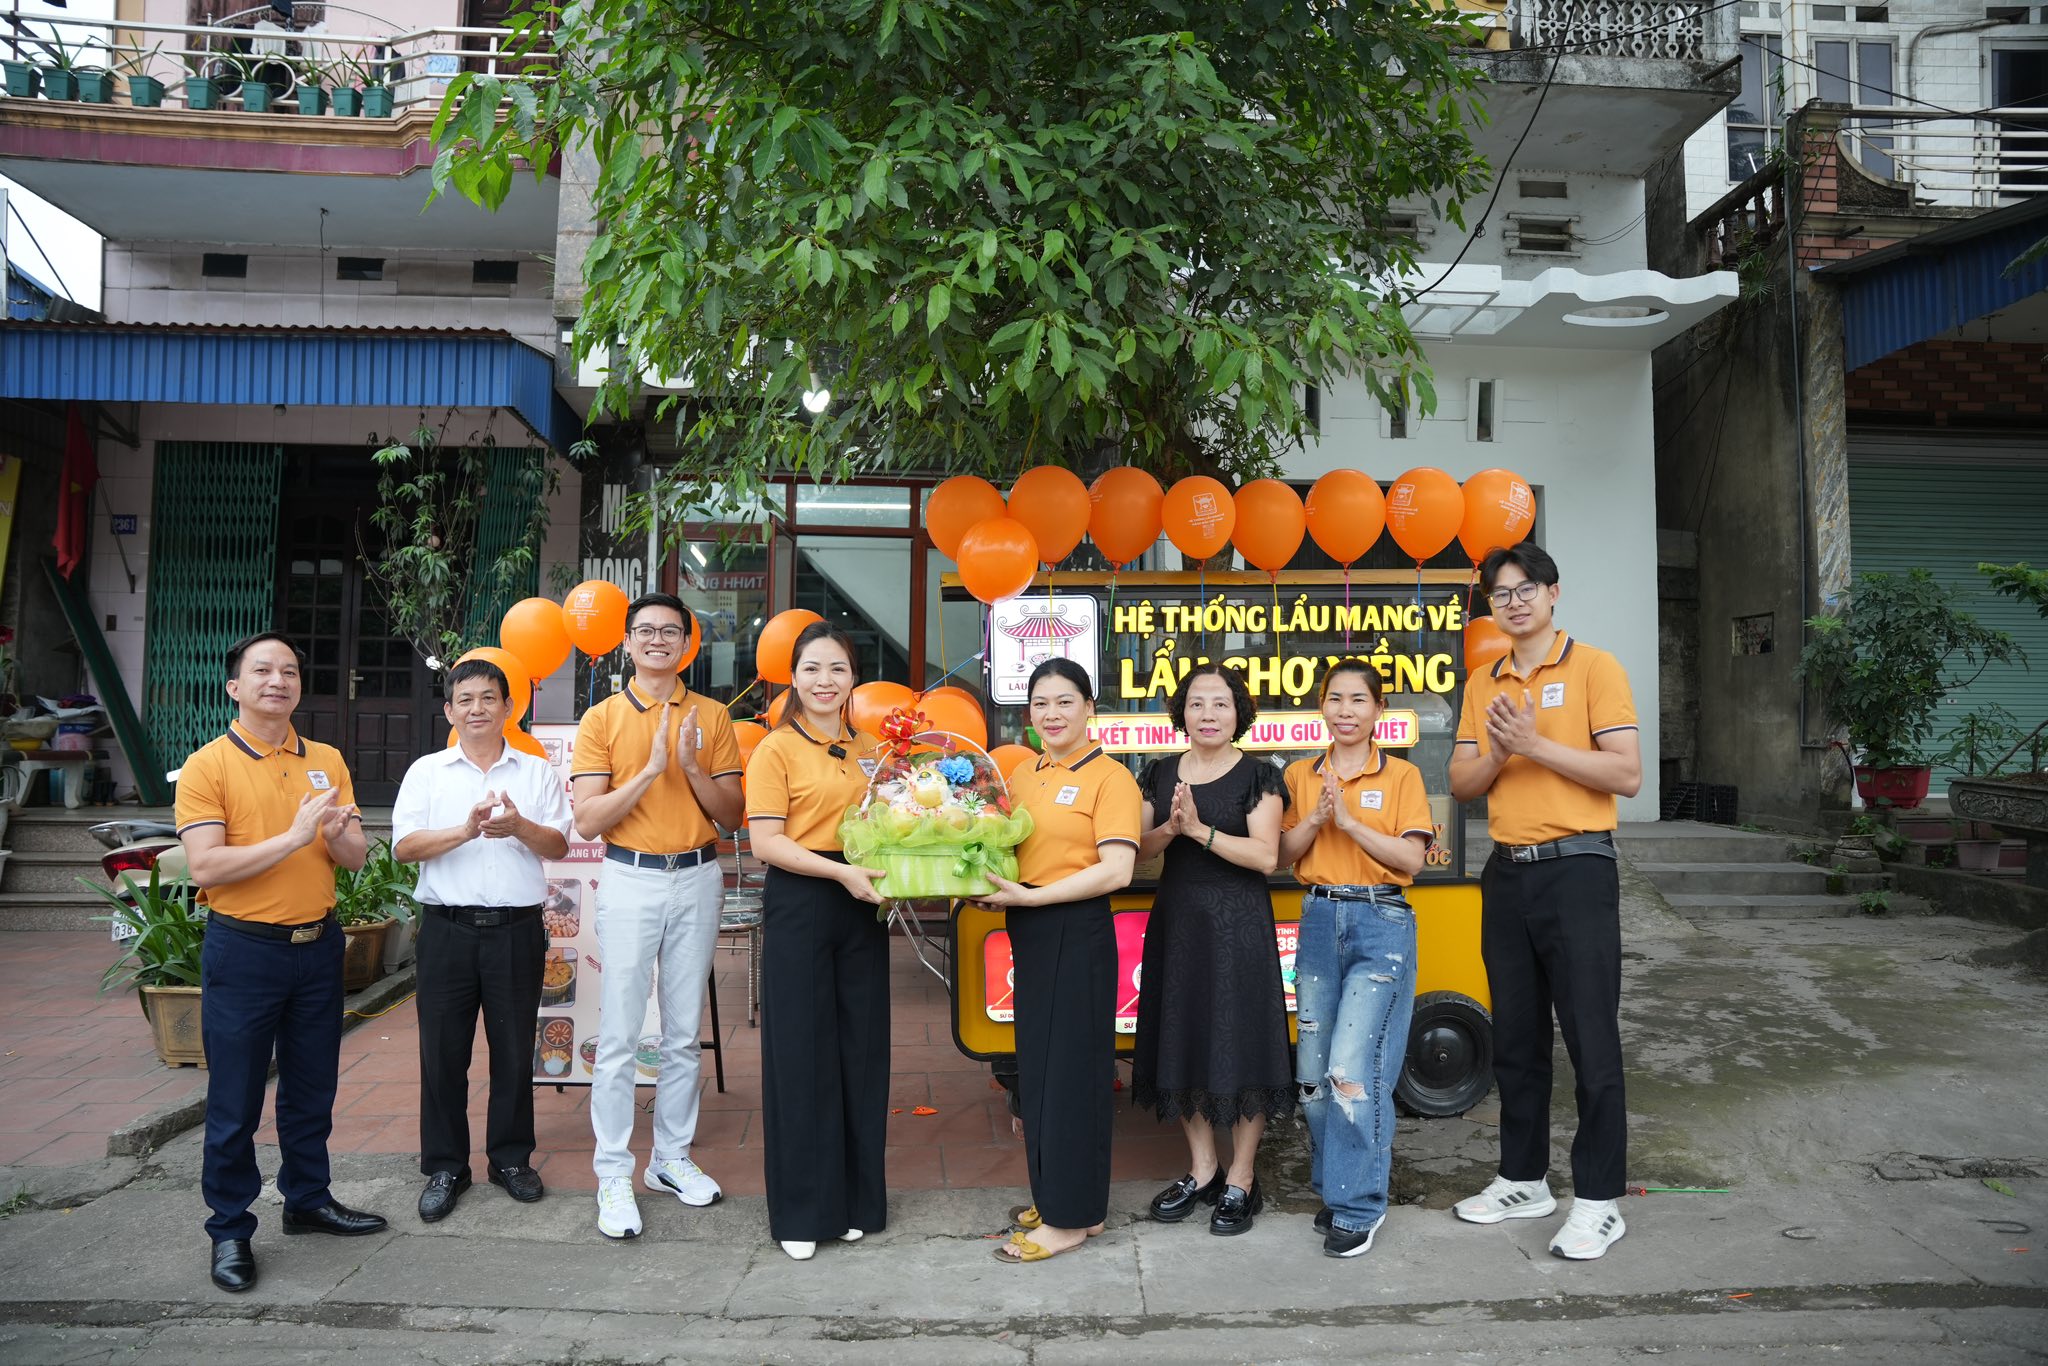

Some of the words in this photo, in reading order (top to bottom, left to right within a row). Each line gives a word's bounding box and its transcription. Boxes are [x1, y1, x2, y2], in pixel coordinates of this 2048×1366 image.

[1114, 600, 1155, 639] HỆ
[1161, 593, 1267, 632] THỐNG
[1272, 593, 1330, 632] LẨU
[1335, 605, 1424, 632] MANG
[1427, 594, 1463, 631] VỀ
[1326, 637, 1456, 694] ỀNG
[1100, 720, 1130, 745] KẾT
[1135, 722, 1178, 745] TÌNH
[1251, 722, 1285, 743] LƯU
[1290, 720, 1322, 741] GIỮ
[1373, 718, 1408, 742] VIỆT
[567, 848, 589, 858] ANG
